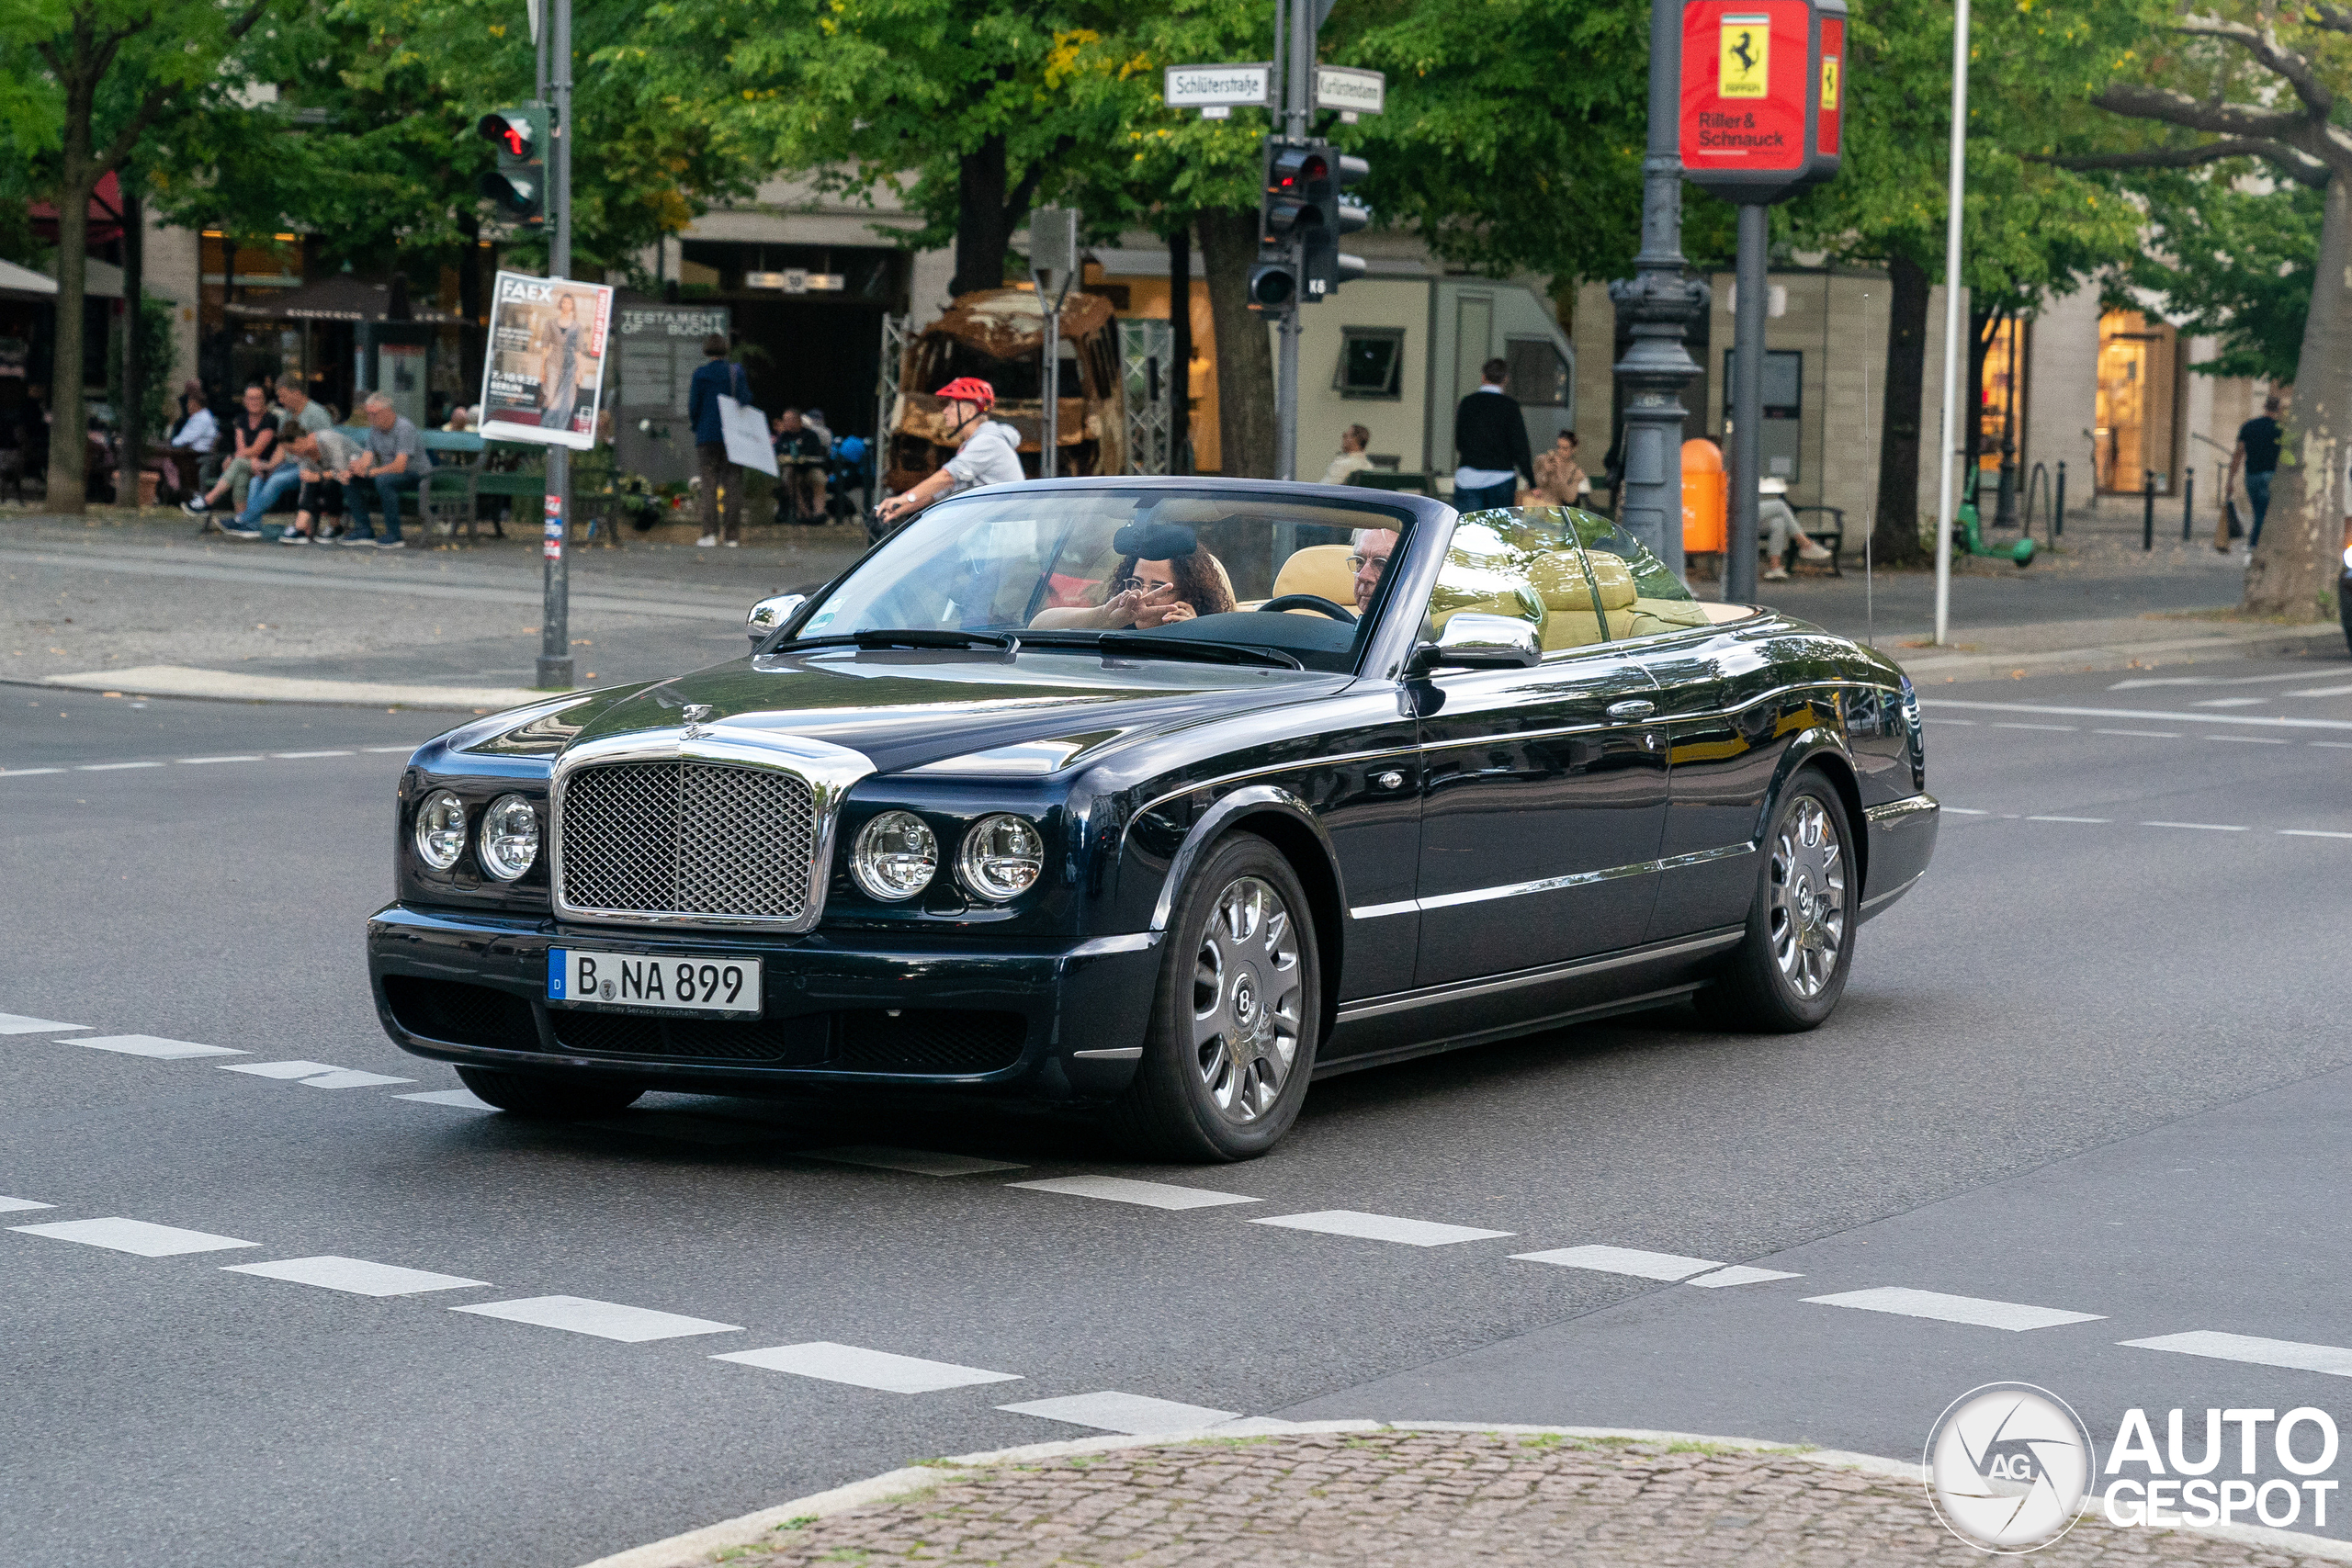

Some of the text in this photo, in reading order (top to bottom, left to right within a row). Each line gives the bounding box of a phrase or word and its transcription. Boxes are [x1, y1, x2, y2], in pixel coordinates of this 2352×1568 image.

[1176, 75, 1259, 96] Schlüterstraße
[1699, 112, 1756, 129] Riller &
[1699, 130, 1784, 147] Schnauck
[502, 278, 553, 303] FAEX
[621, 310, 725, 324] TESTAMENT
[621, 321, 724, 336] OF BUCHA
[490, 380, 523, 393] BERLIN
[553, 956, 743, 1004] D B NA 899
[1238, 989, 1250, 1012] B
[627, 1006, 654, 1015] Service
